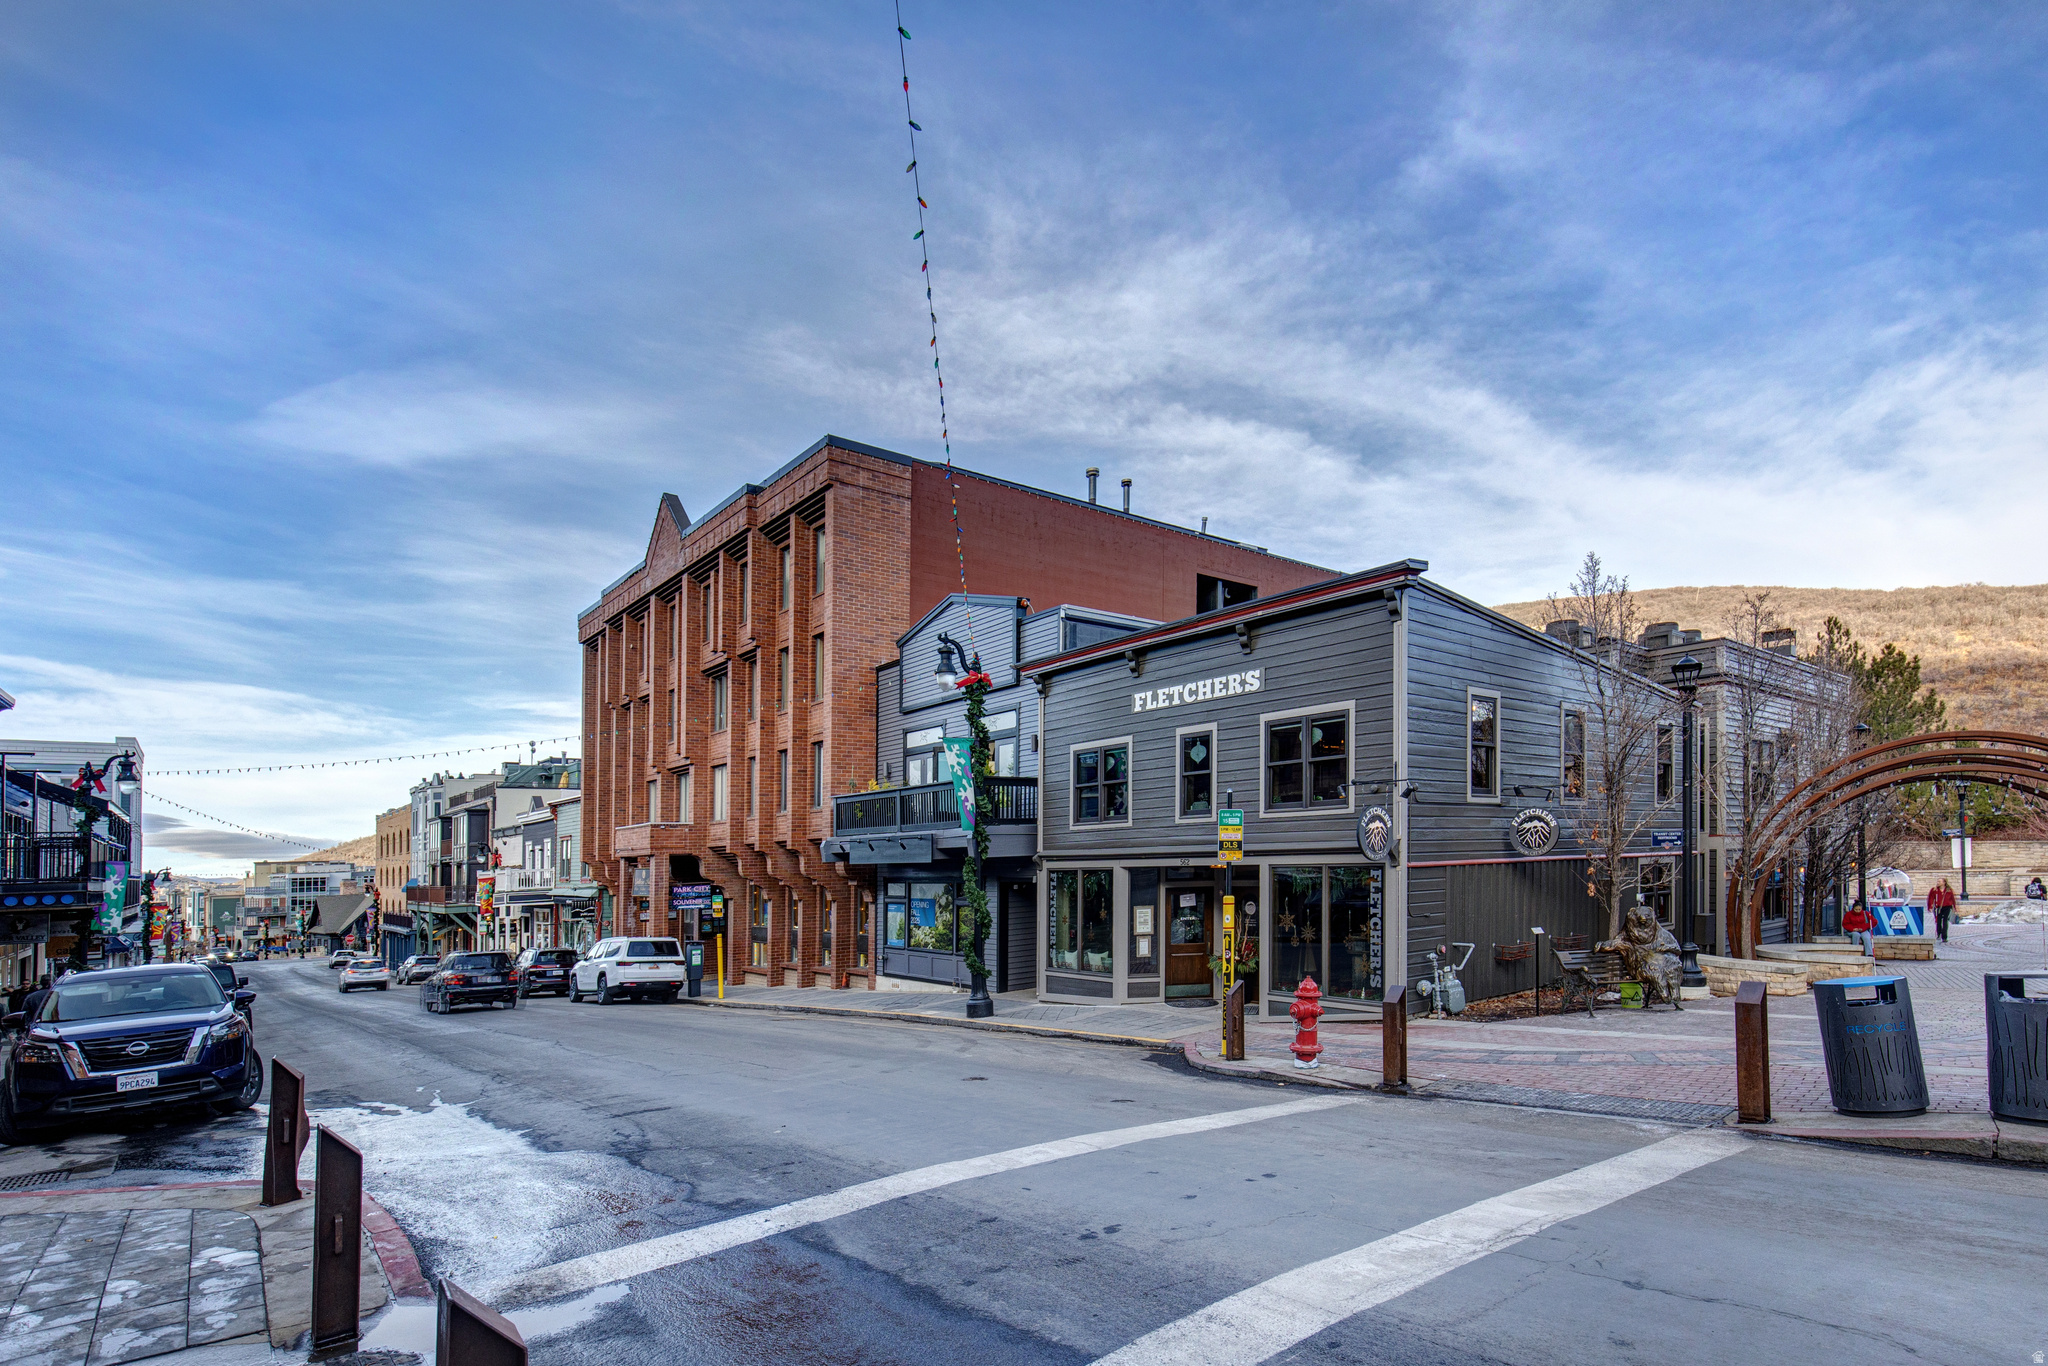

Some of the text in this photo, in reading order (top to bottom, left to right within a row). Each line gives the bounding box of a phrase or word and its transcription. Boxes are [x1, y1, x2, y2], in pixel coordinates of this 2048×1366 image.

[1134, 670, 1260, 712] FLETCHER'S
[1511, 808, 1557, 827] FLETCHER'S
[911, 901, 929, 909] OPENING
[1370, 869, 1382, 988] FLETCHER'S
[1846, 1021, 1907, 1034] RECYCLE
[120, 1078, 155, 1090] 9PCA294
